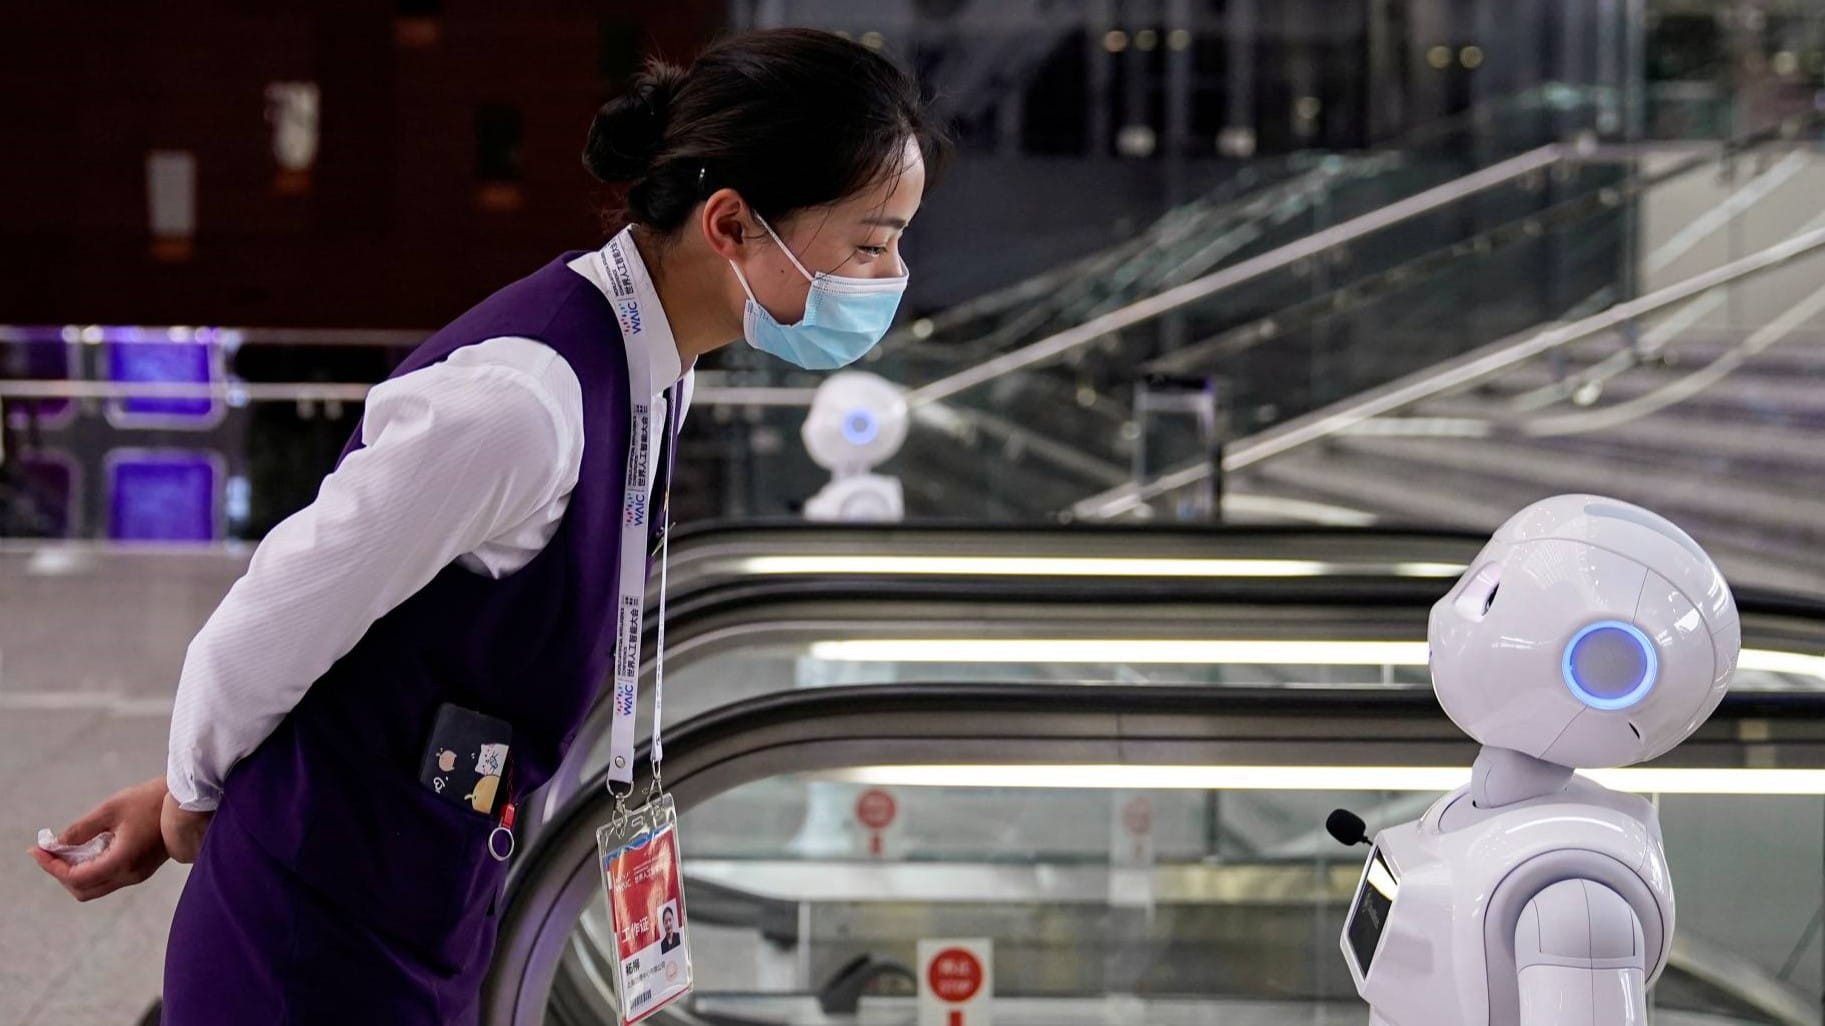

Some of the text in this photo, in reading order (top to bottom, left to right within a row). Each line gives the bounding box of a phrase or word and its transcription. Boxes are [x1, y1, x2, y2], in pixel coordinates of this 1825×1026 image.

[628, 301, 642, 335] WAIC
[638, 416, 648, 487] 世界人工智能大会
[634, 494, 645, 527] WAIC
[627, 608, 639, 678] 世界人工智能大会
[623, 684, 634, 716] WAIC
[622, 916, 649, 943] 工作证
